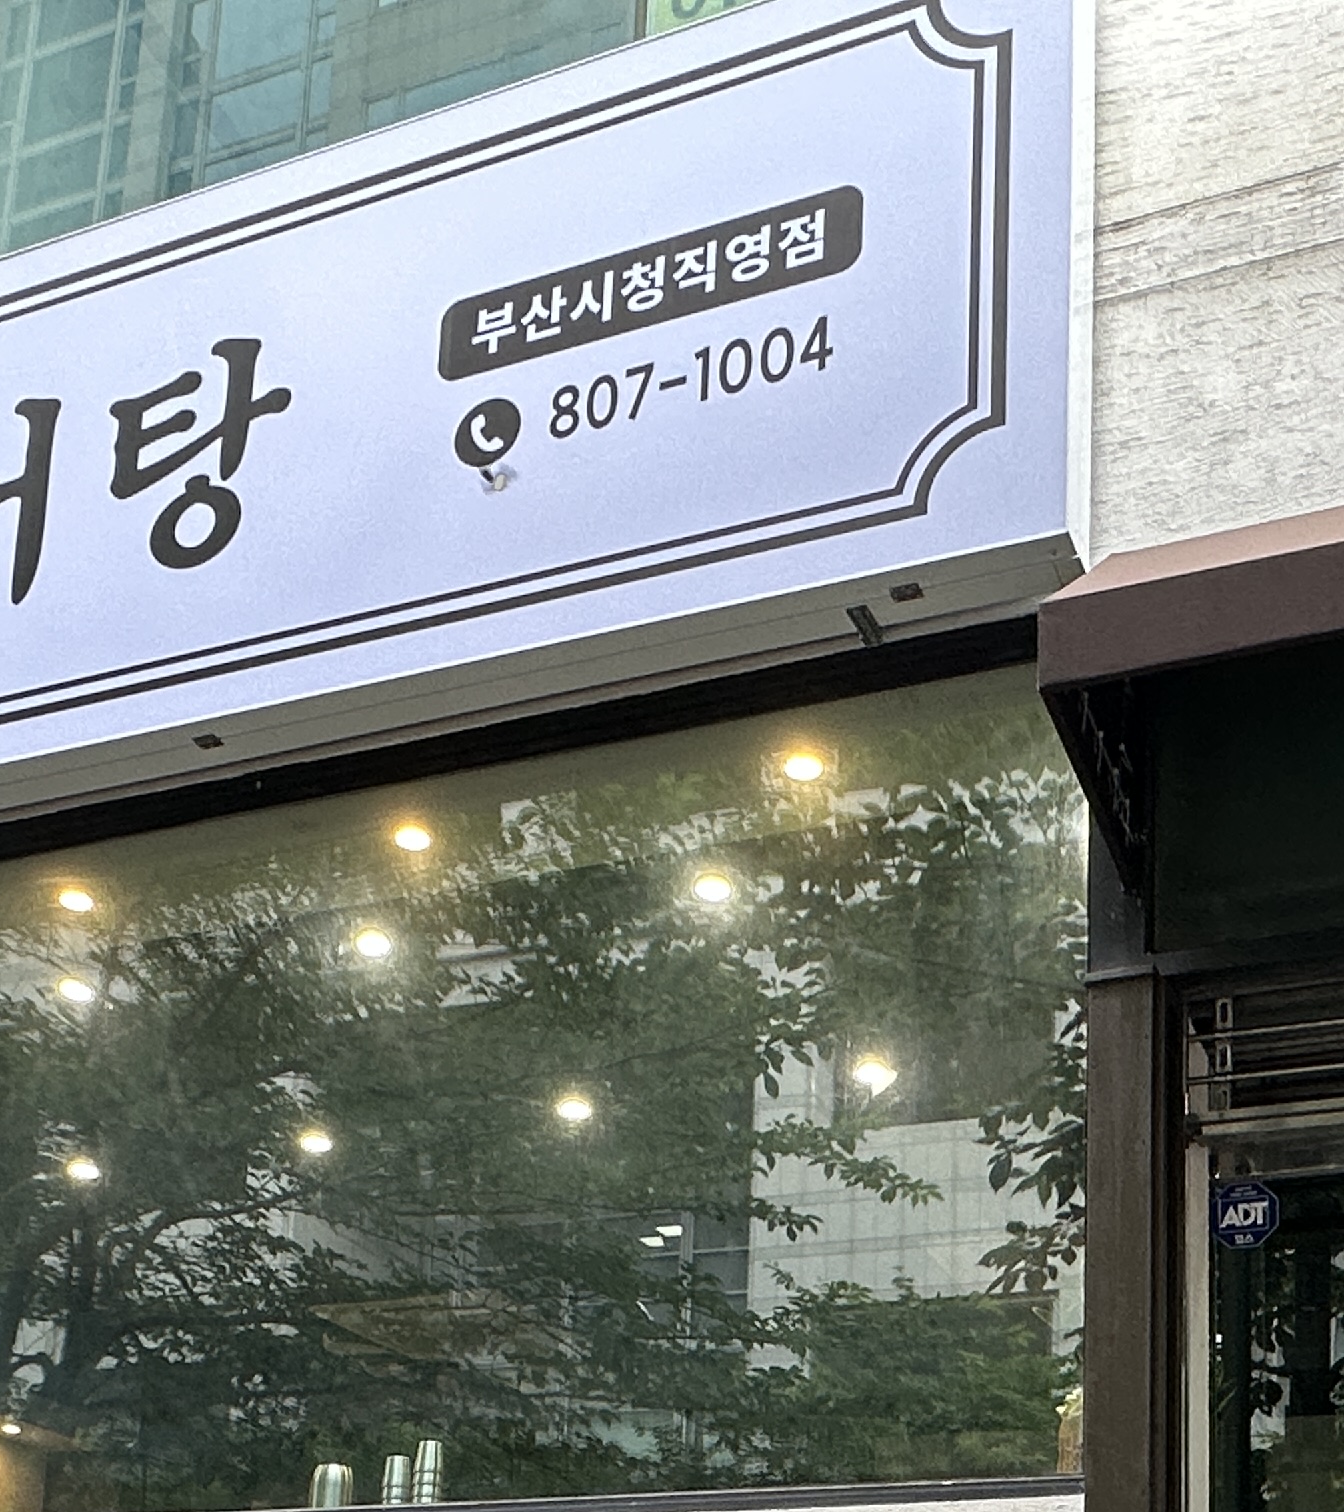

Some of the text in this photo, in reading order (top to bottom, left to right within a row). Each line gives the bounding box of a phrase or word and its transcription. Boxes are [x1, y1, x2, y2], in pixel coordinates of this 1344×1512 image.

[468, 205, 829, 350] 부산시청직영점
[549, 313, 834, 439] 807-1004
[1219, 1201, 1268, 1227] ADT
